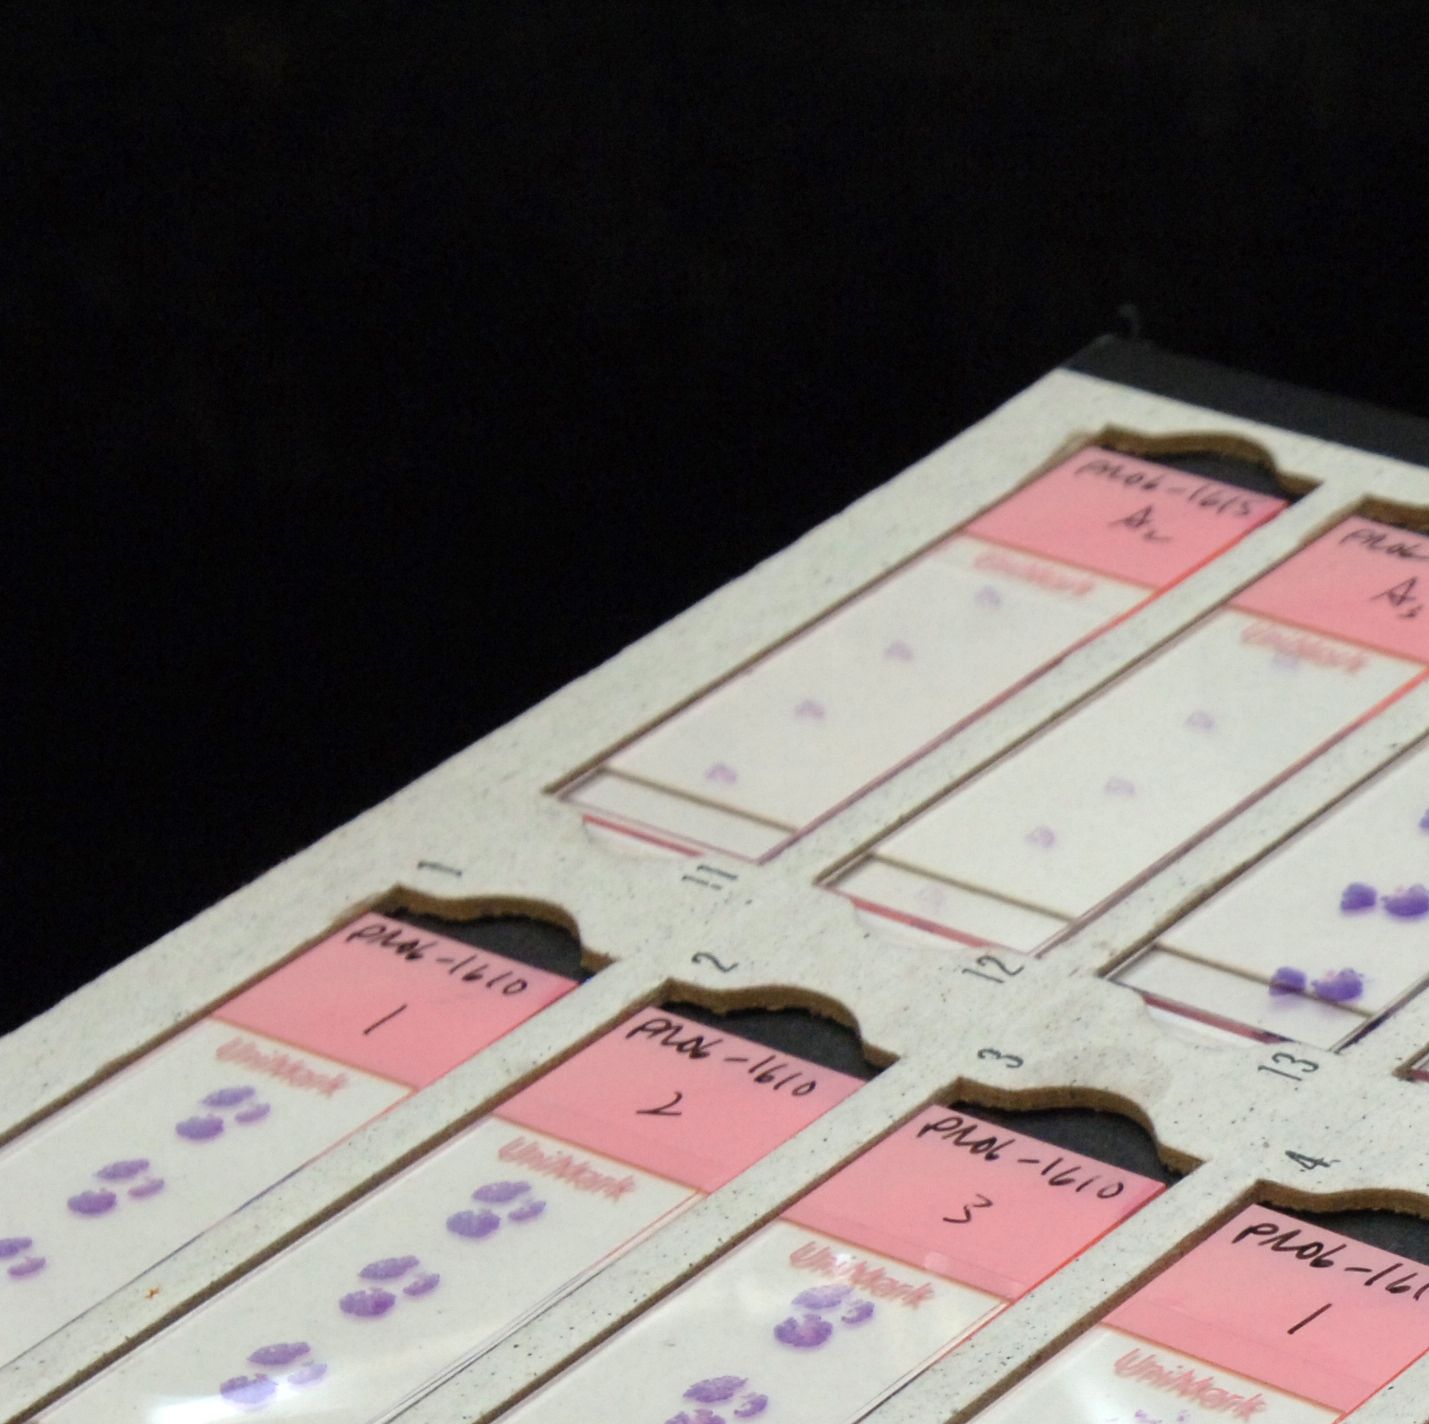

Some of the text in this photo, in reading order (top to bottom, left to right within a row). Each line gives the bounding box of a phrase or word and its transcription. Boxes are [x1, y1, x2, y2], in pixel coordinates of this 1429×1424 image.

[690, 951, 740, 974] 2
[960, 953, 1026, 984] 12
[362, 1003, 408, 1036] 1
[976, 1047, 1024, 1069] 3
[1256, 1051, 1320, 1082] 13
[636, 1091, 684, 1117] 2
[1284, 1149, 1339, 1172] 4
[942, 1193, 994, 1224] 3
[1286, 1303, 1333, 1336] 1
[1112, 1347, 1270, 1424] UniMark
